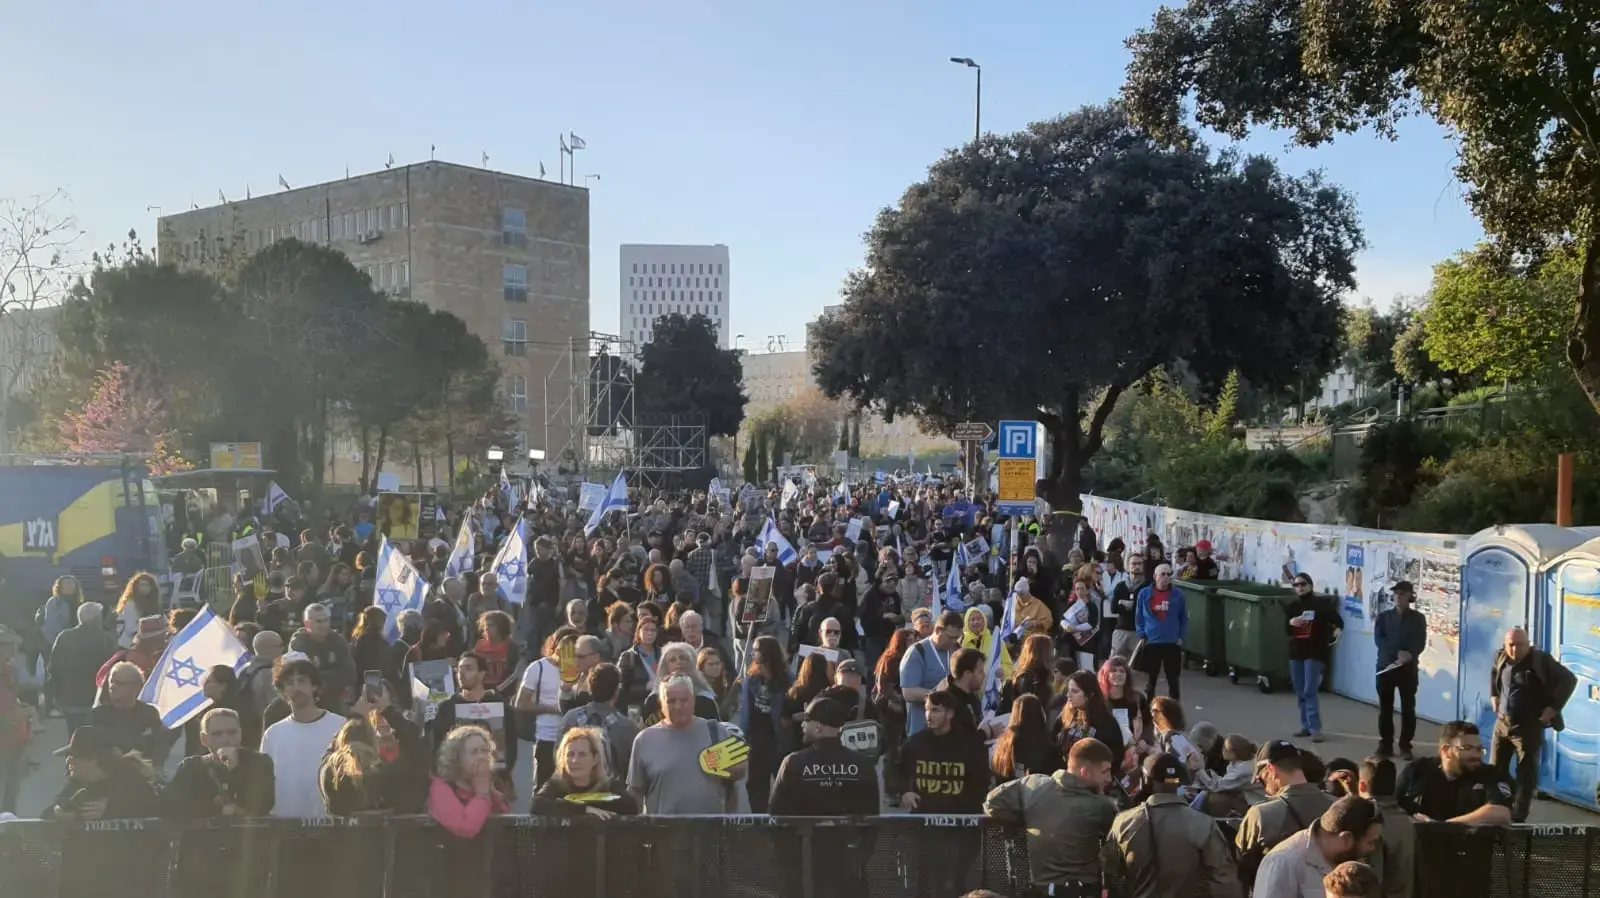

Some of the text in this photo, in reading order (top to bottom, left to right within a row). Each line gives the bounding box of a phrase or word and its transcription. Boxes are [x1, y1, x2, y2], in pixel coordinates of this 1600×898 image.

[803, 764, 859, 776] APOLLO
[916, 760, 965, 777] הדחה
[916, 778, 965, 795] עכשיו
